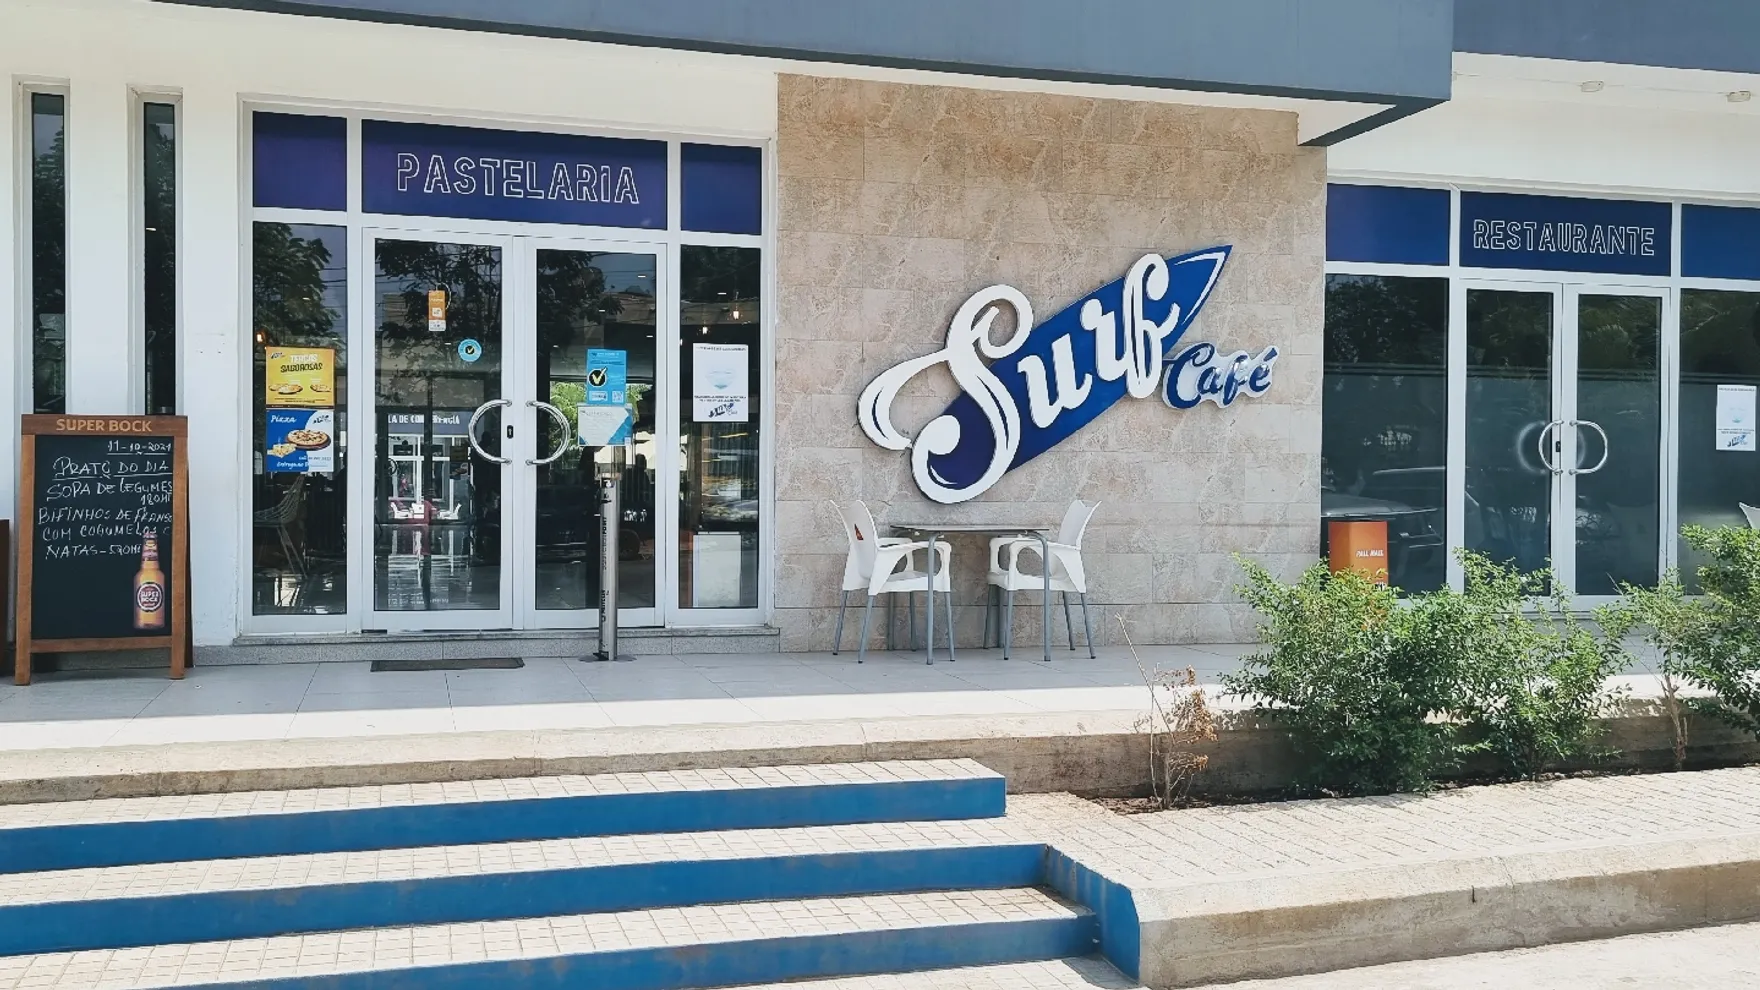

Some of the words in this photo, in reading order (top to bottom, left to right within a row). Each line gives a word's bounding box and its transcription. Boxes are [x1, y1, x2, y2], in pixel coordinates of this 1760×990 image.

[397, 152, 640, 205] PASTELARIA
[1473, 219, 1655, 256] RESTAURANTE
[857, 253, 1181, 504] Surf
[1166, 342, 1278, 409] Café
[56, 419, 105, 431] SUPER
[108, 420, 152, 432] BOCK
[270, 414, 297, 424] Pizza
[52, 456, 111, 476] PRATO
[117, 461, 139, 474] DO
[145, 460, 169, 473] DIA
[46, 481, 91, 502] SOPA
[115, 508, 133, 520] DE
[42, 526, 72, 541] COM
